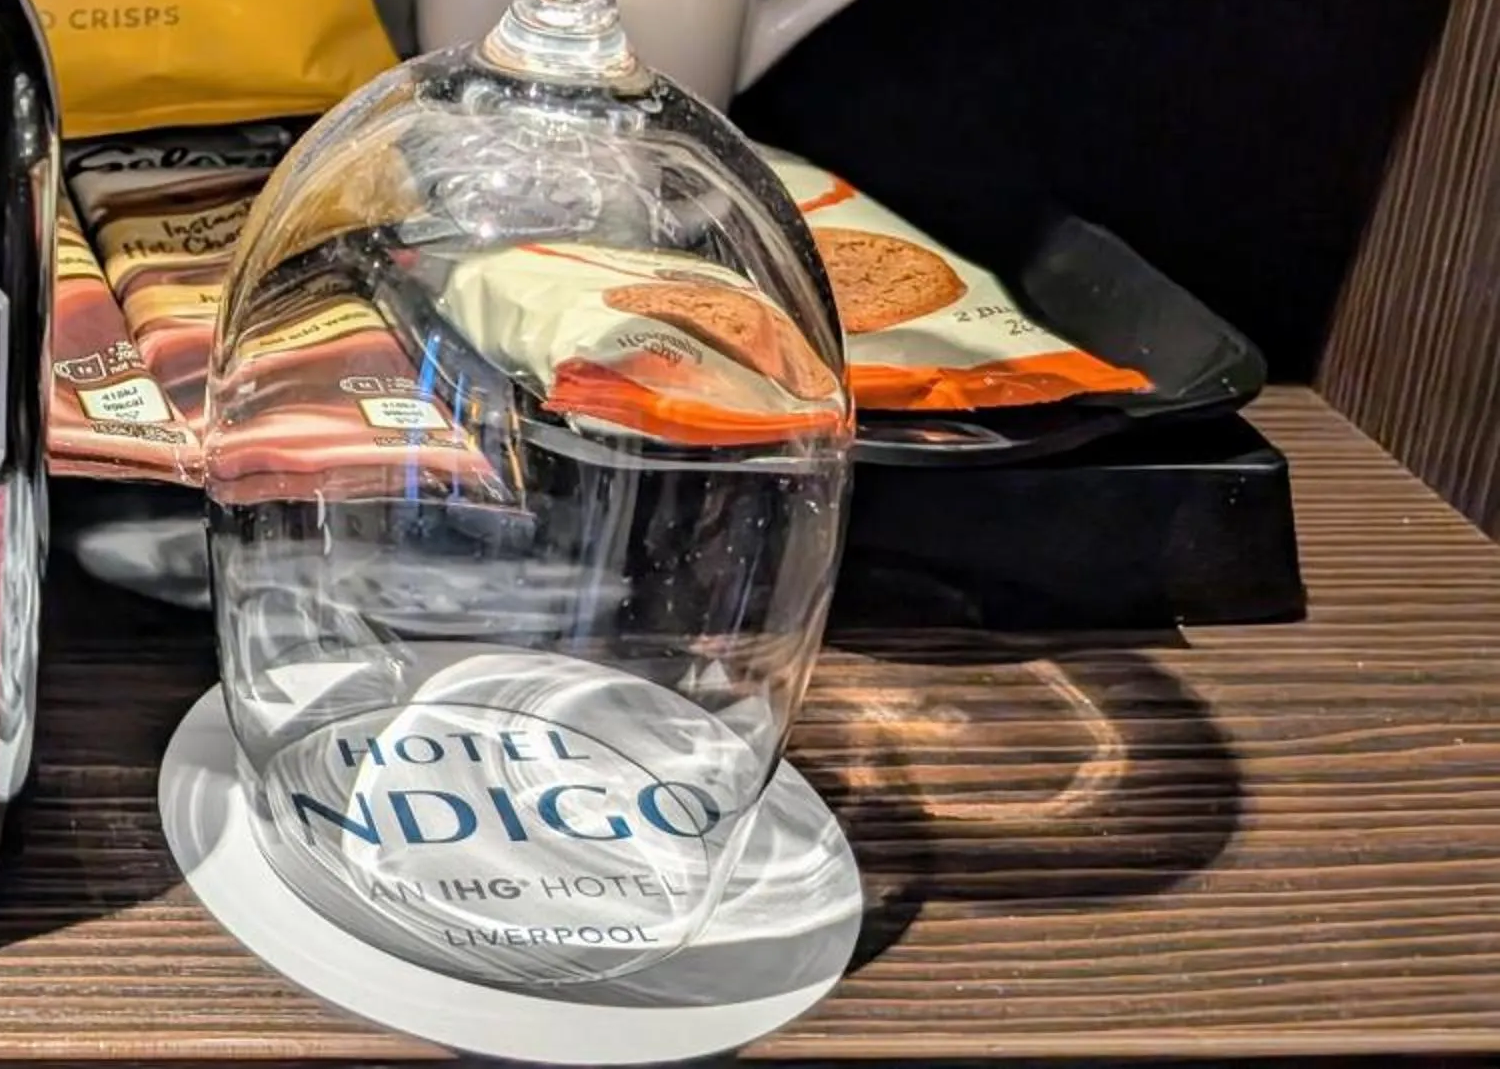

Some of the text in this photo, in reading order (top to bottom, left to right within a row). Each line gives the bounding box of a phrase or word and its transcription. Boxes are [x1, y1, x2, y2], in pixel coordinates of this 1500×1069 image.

[68, 6, 181, 31] CRISPS
[337, 730, 591, 768] HOTEL
[291, 781, 722, 847] NDIGO
[369, 880, 427, 903] AN
[541, 873, 690, 900] HOTEL
[443, 924, 659, 948] LIVERPOOL
